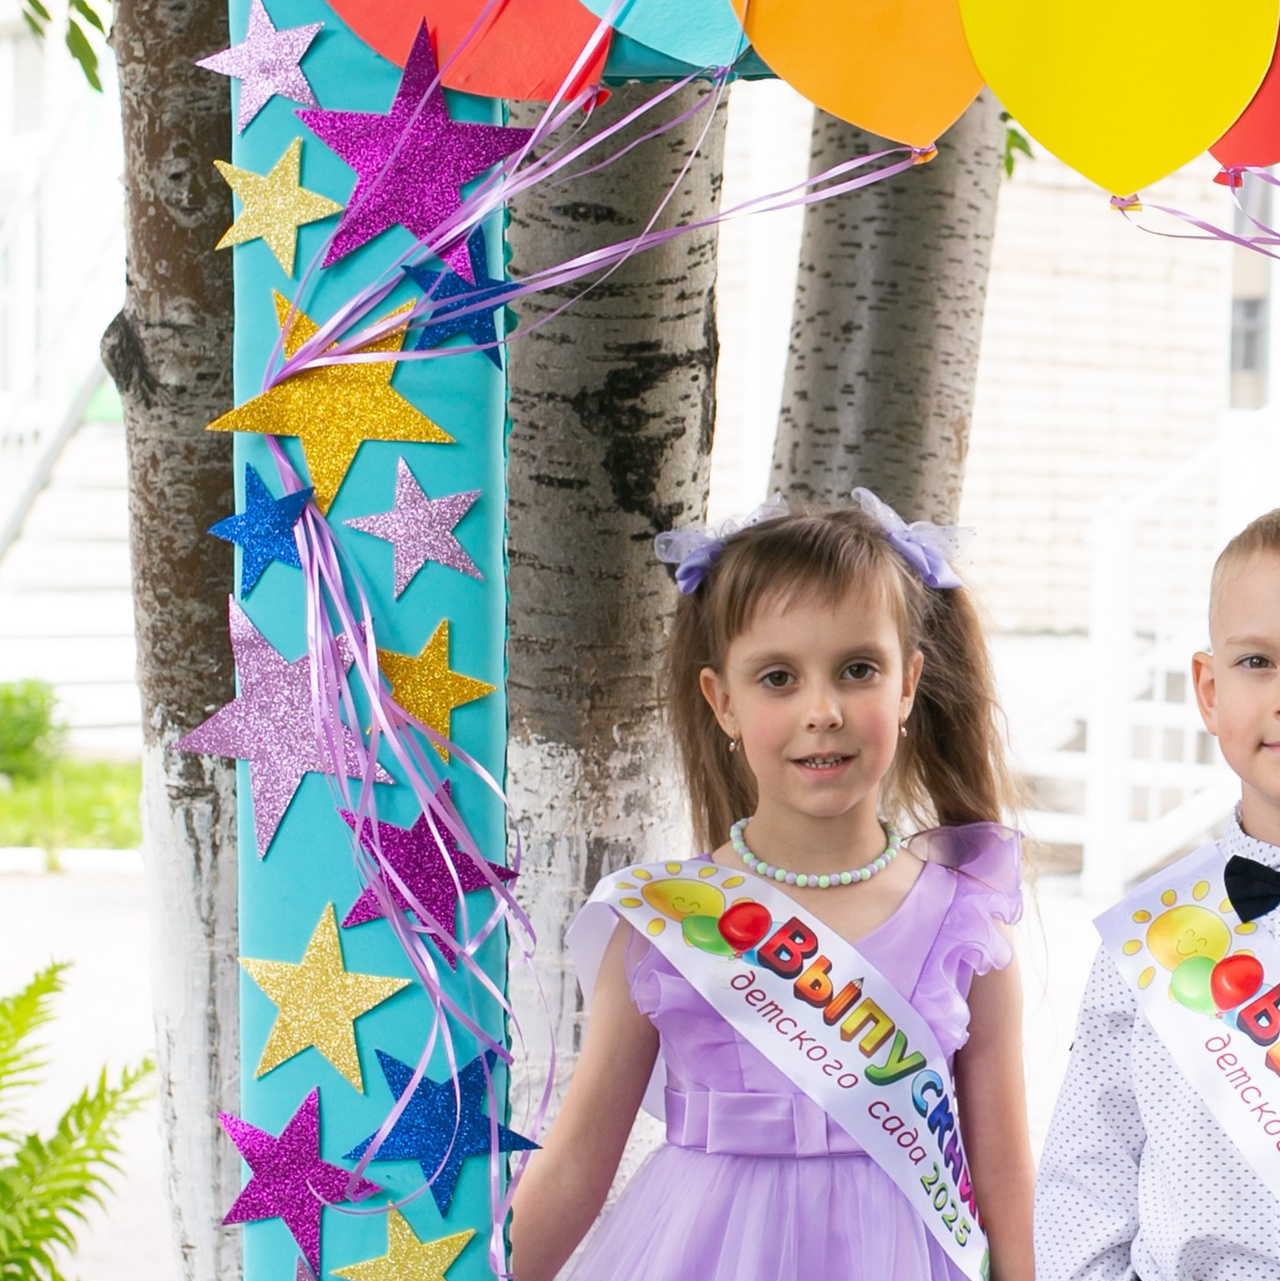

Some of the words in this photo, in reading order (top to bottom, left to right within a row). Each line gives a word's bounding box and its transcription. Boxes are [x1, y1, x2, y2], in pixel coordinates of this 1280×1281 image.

[729, 970, 859, 1090] детского
[868, 1099, 928, 1166] сада
[919, 1161, 971, 1247] 2025
[757, 916, 986, 1235] Выпускни
